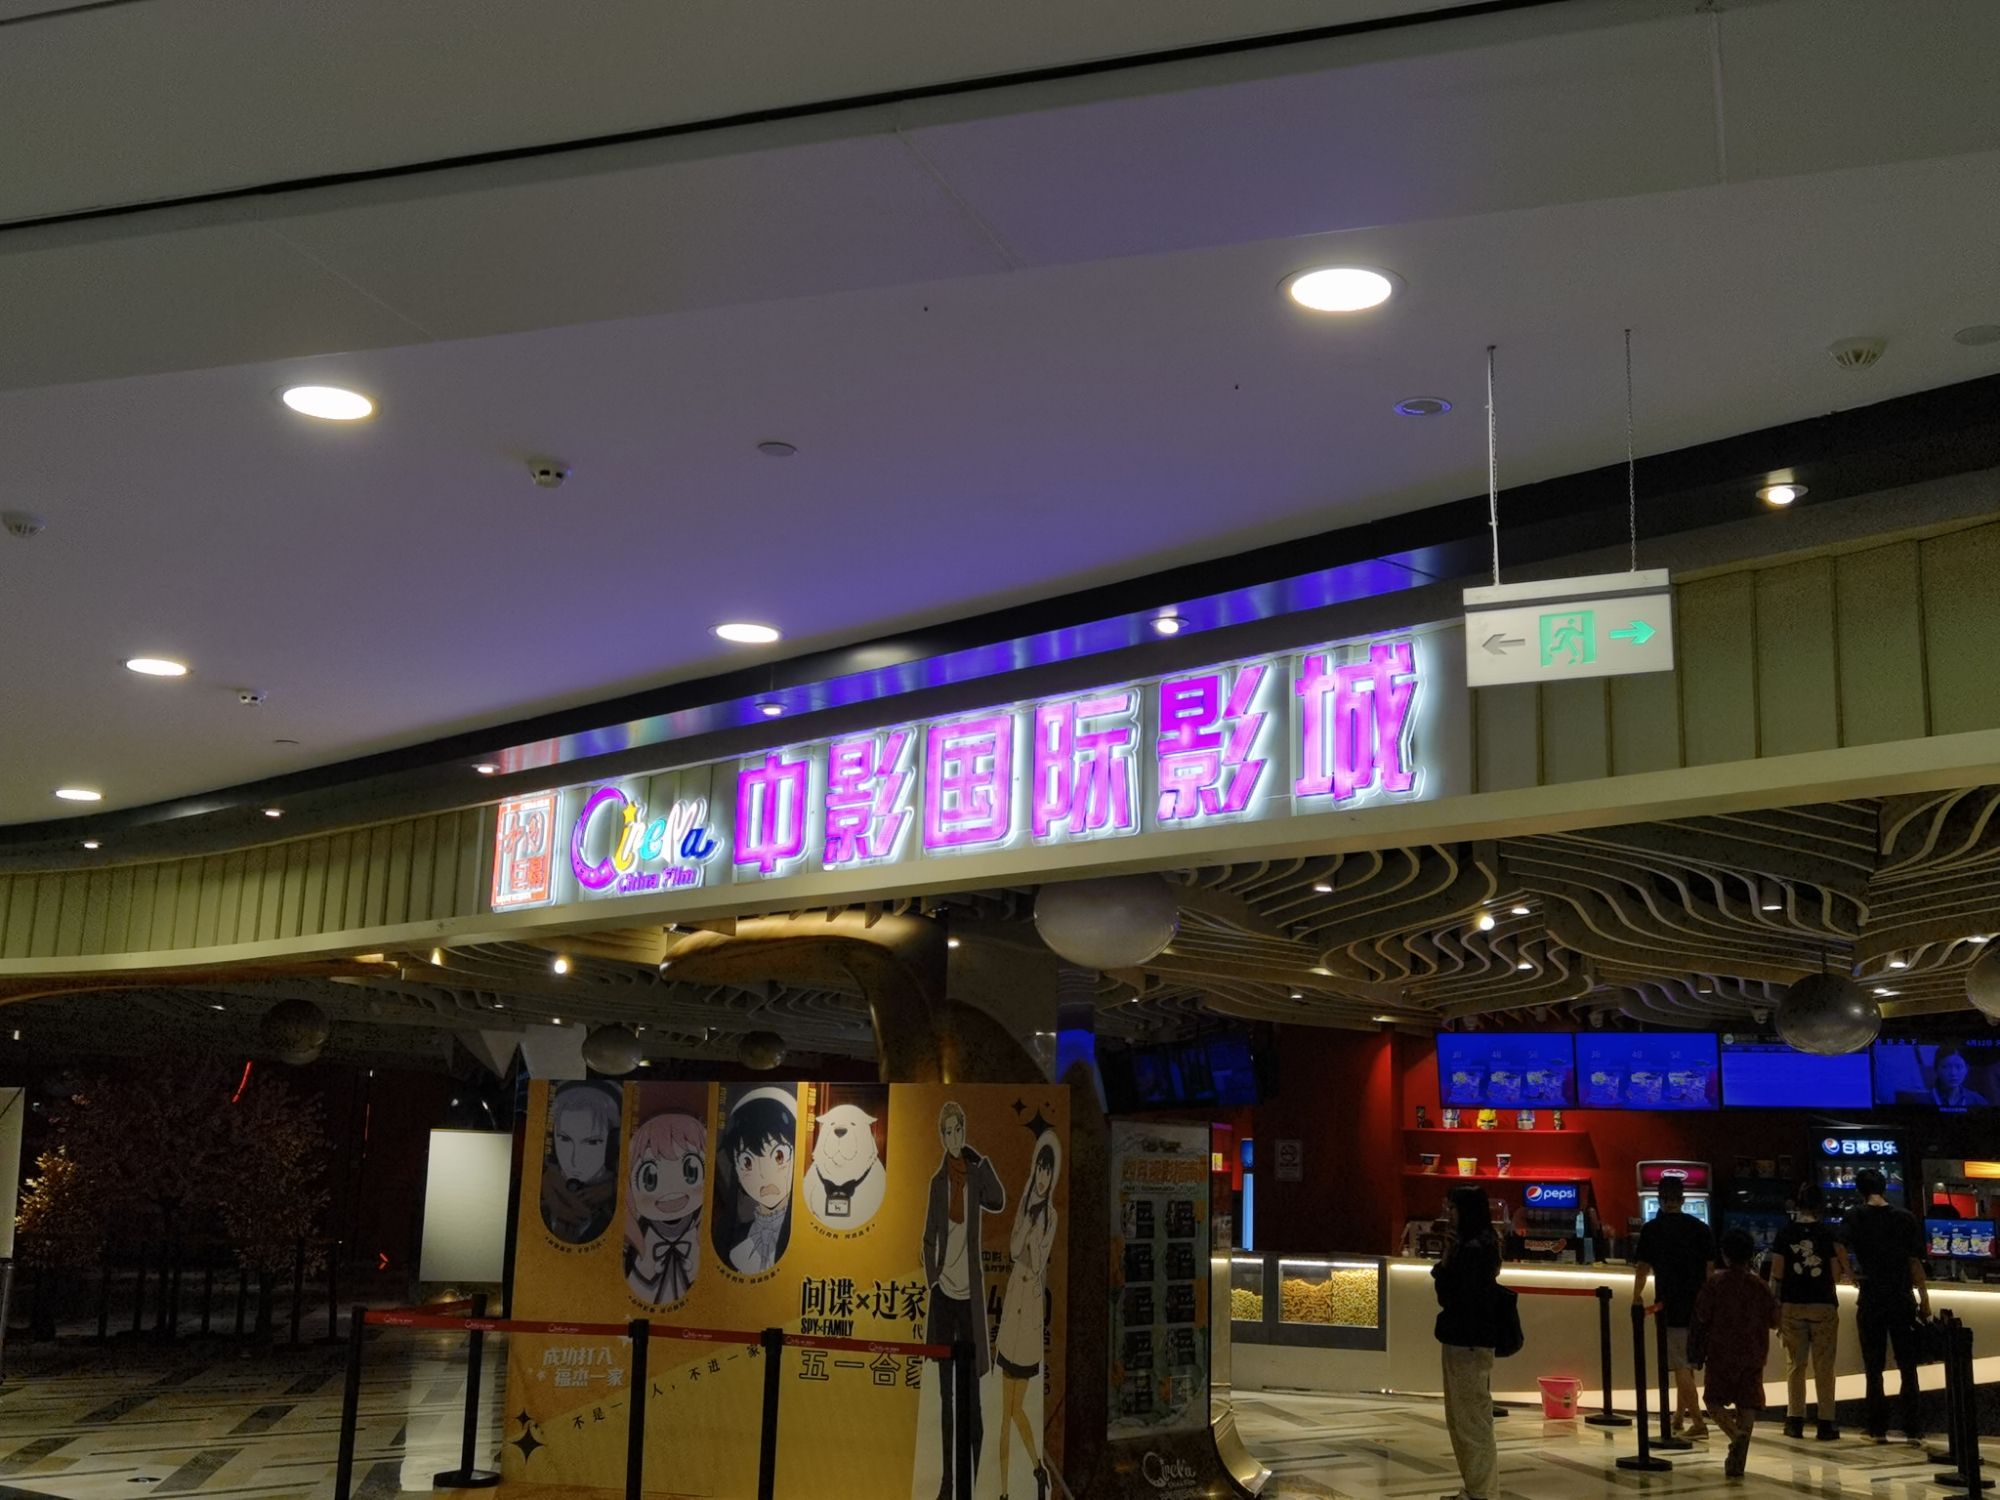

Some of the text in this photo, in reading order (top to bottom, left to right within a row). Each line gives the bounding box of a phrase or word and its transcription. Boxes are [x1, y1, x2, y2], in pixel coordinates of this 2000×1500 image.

[733, 641, 1417, 874] 中影国际影城
[616, 866, 698, 893] China Film
[1841, 1139, 1899, 1155] 百事可乐
[1543, 1188, 1576, 1202] pepsi
